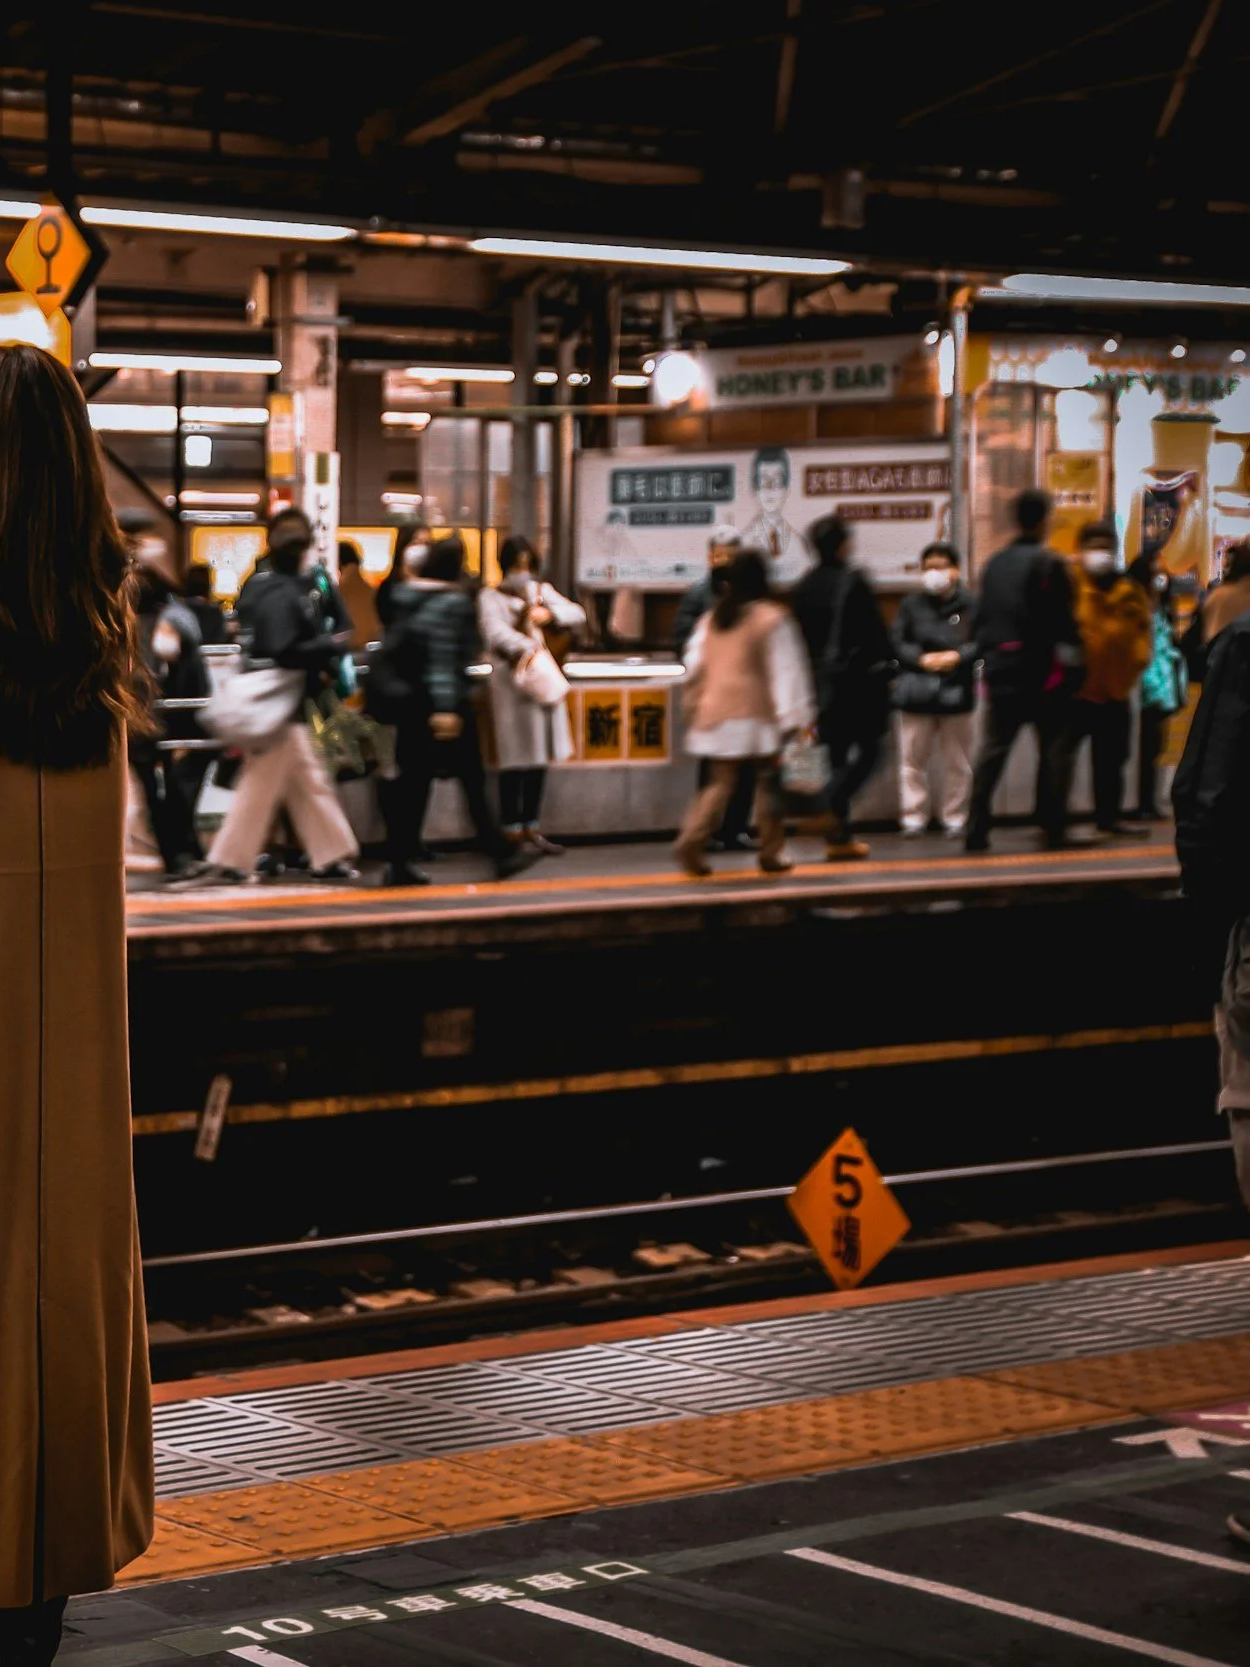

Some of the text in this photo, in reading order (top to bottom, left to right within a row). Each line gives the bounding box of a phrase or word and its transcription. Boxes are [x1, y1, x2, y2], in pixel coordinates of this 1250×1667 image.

[716, 362, 888, 397] HONEY'S BAR
[588, 703, 666, 747] 新宿
[833, 1153, 863, 1209] 5
